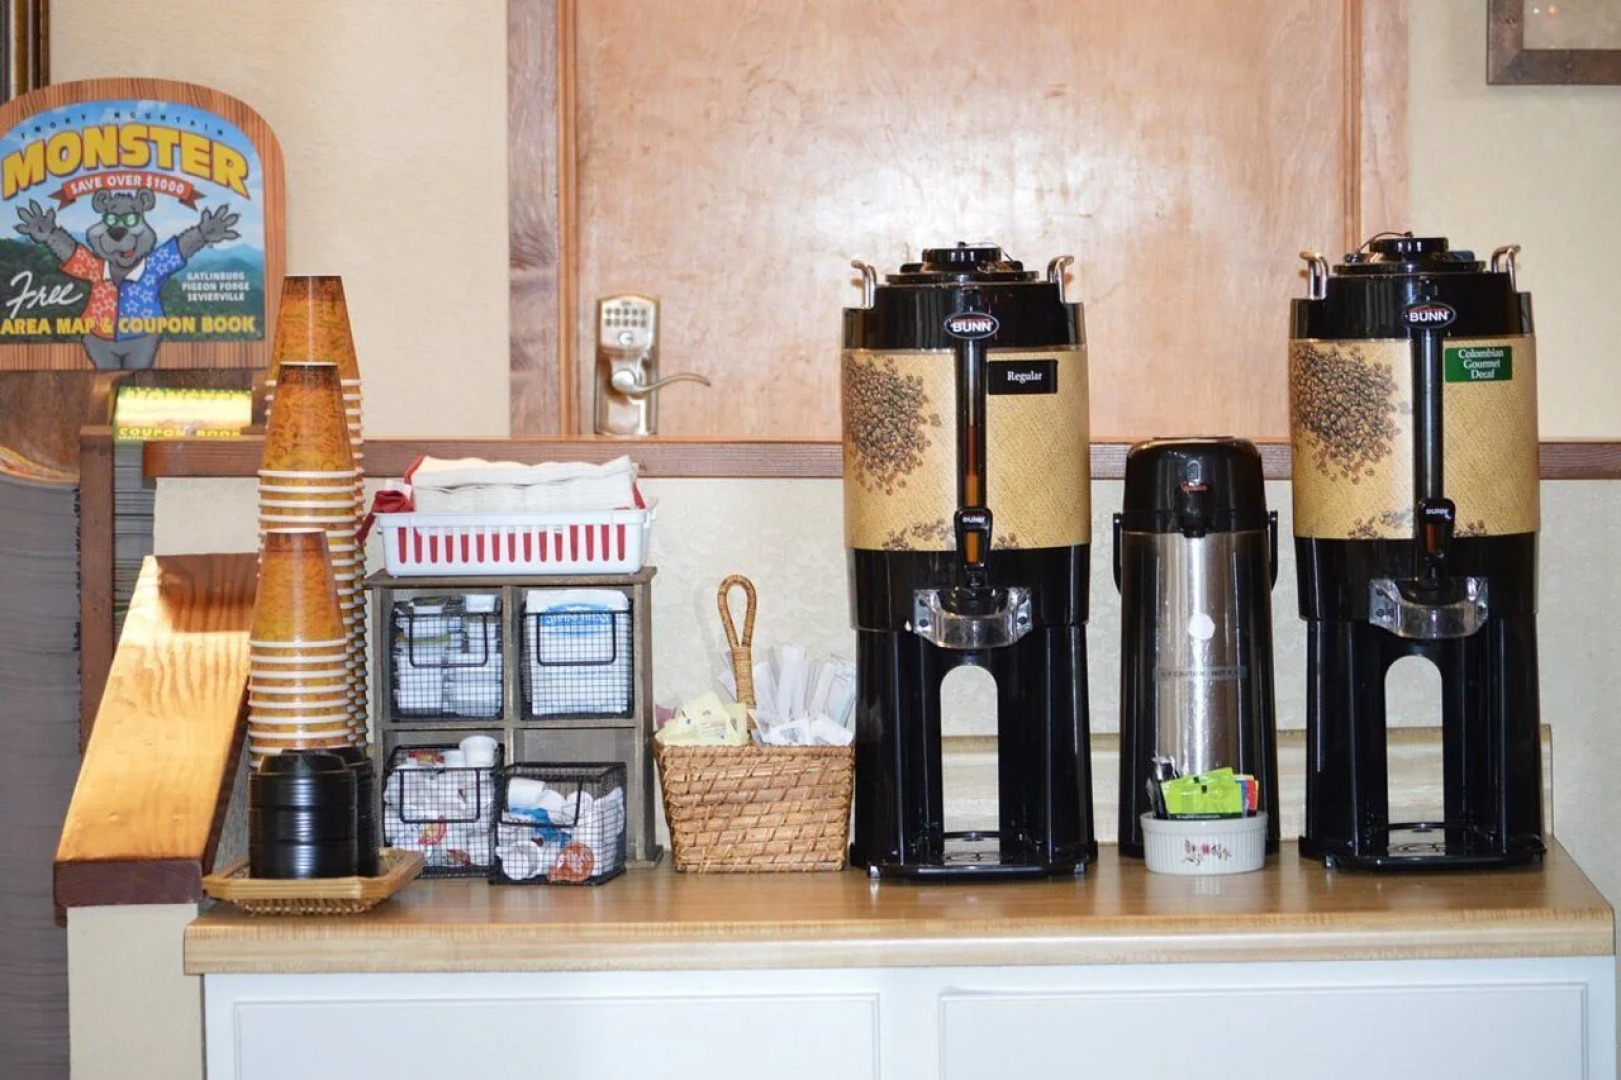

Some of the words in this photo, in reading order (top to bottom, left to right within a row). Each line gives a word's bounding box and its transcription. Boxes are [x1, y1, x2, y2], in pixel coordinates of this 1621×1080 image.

[113, 111, 224, 136] MOUNTAIN
[2, 122, 251, 200] MONSTER
[70, 176, 102, 195] SAVE
[107, 175, 142, 187] OVER
[146, 176, 185, 194] $1000
[186, 271, 245, 281] GATLINBURG
[181, 282, 217, 291] PIGEON
[219, 282, 250, 291] FORGE
[5, 270, 84, 320] Free
[187, 292, 245, 302] SEVIERVILLE
[1409, 310, 1449, 323] BUNN
[0, 317, 52, 335] AREA
[56, 317, 96, 335] MAP
[102, 317, 115, 335] &
[118, 316, 196, 335] COUPON
[201, 317, 256, 334] BOOK
[951, 321, 992, 333] BUNN
[1458, 348, 1504, 359] Colombian
[1463, 359, 1501, 369] Gourmet
[1007, 370, 1043, 385] Regular
[1471, 369, 1495, 380] Decaf
